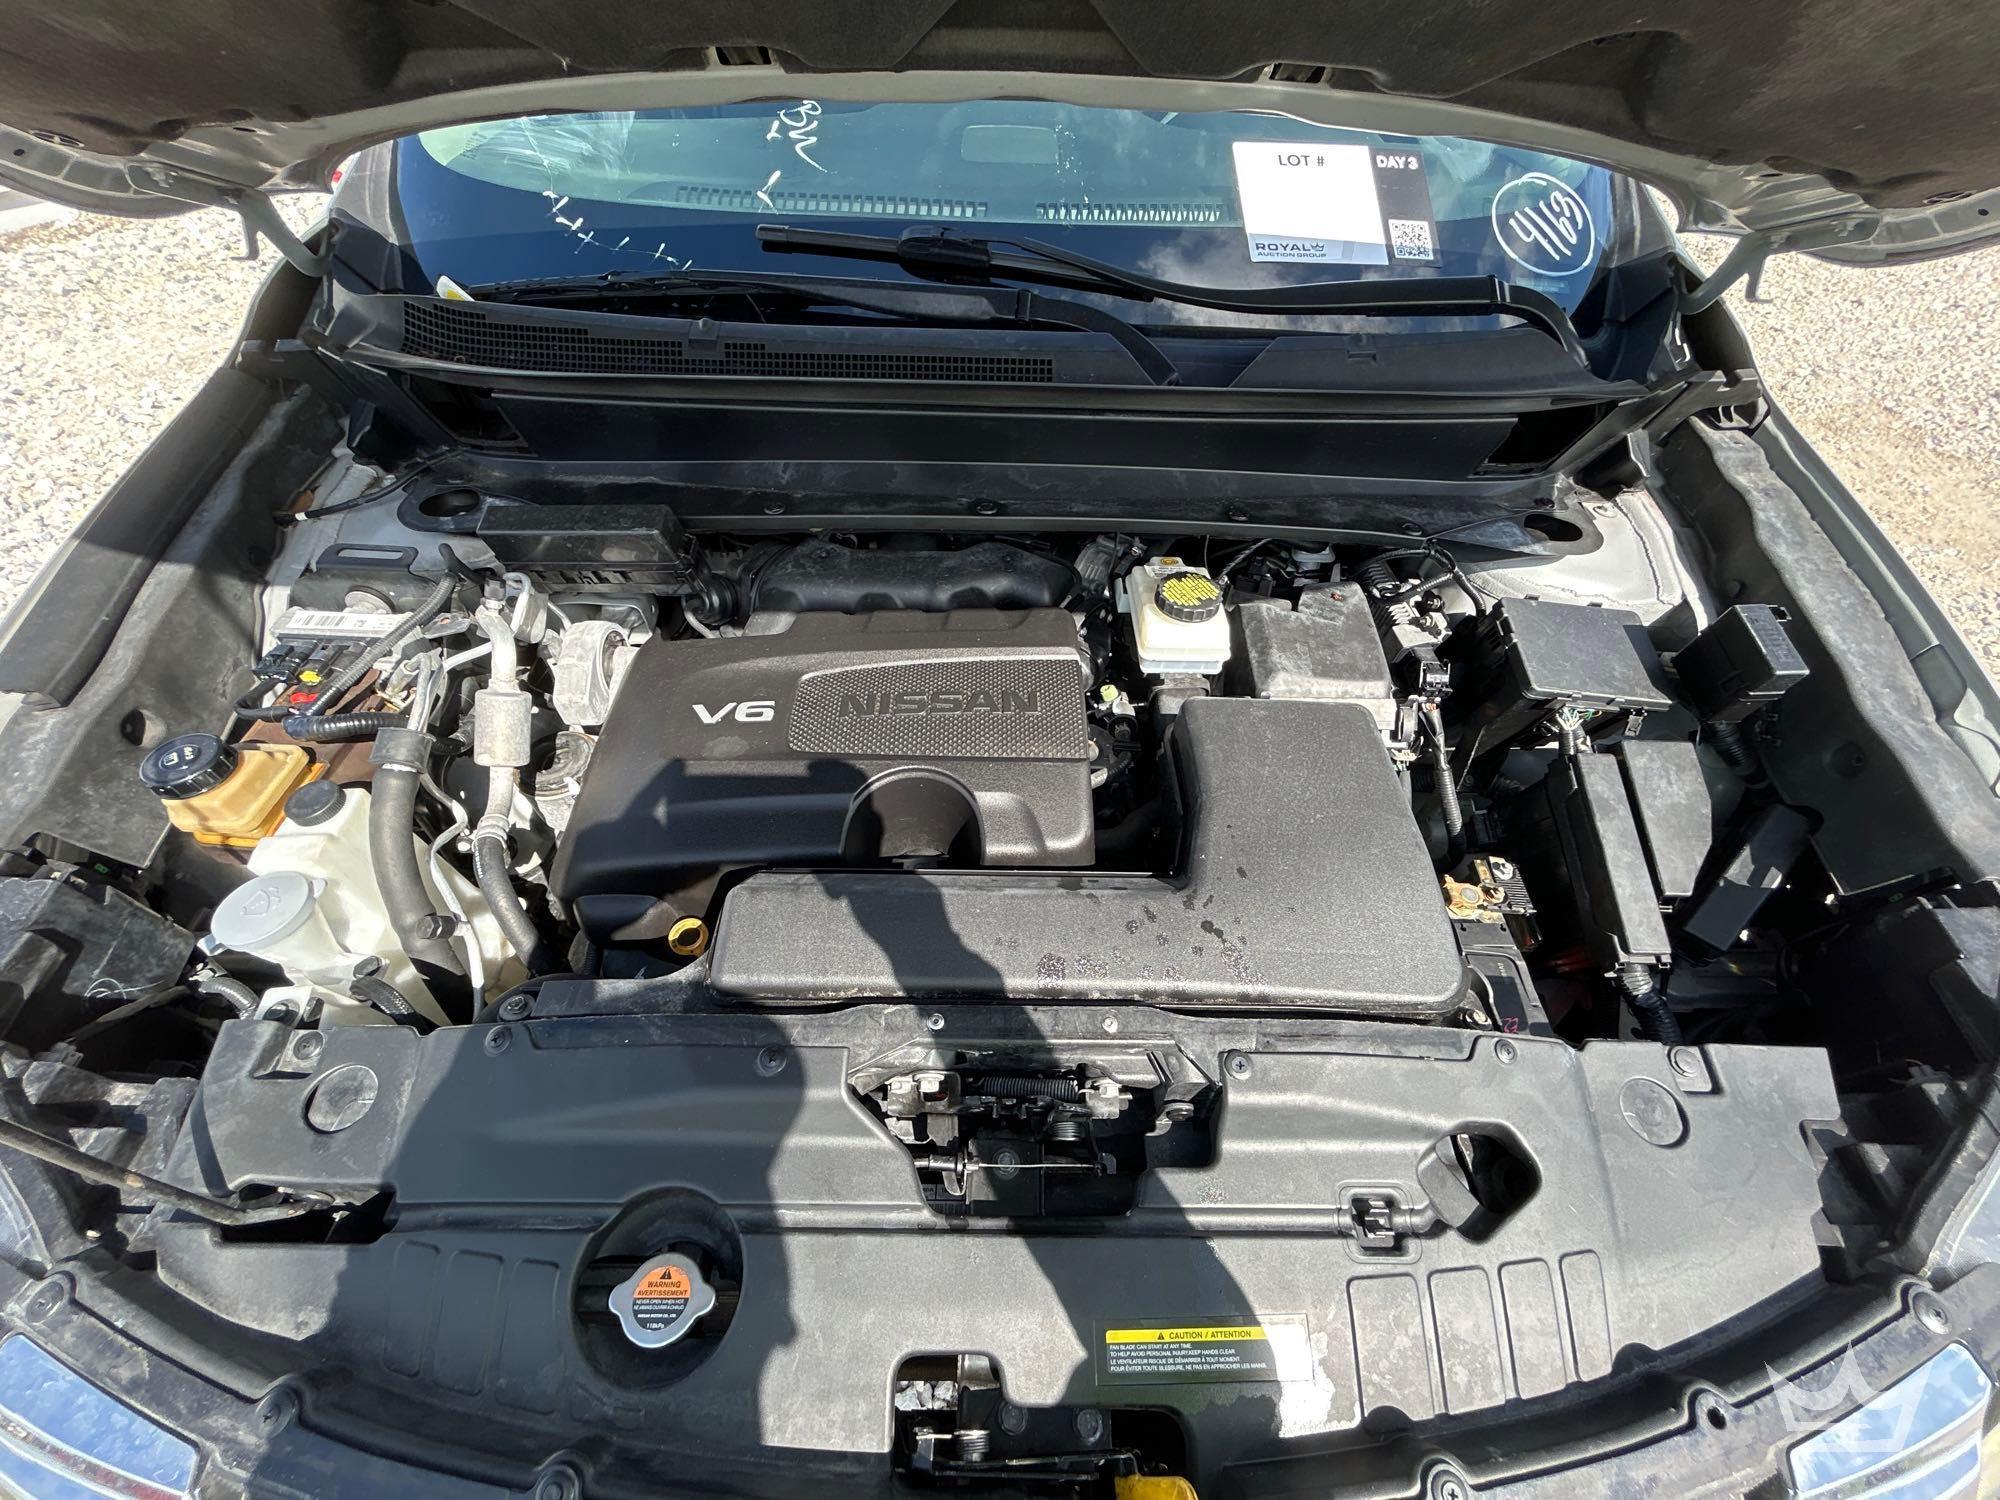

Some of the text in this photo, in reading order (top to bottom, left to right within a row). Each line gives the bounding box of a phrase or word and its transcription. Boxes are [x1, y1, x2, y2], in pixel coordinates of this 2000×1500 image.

[1278, 154, 1324, 167] LOT #
[1376, 155, 1419, 170] DAY 3
[1255, 243, 1311, 252] ROYAL
[840, 689, 1041, 718] NISSAN
[691, 700, 775, 723] V6
[1169, 1331, 1203, 1340] CAUTION
[1211, 1330, 1252, 1339] ATTENTION
